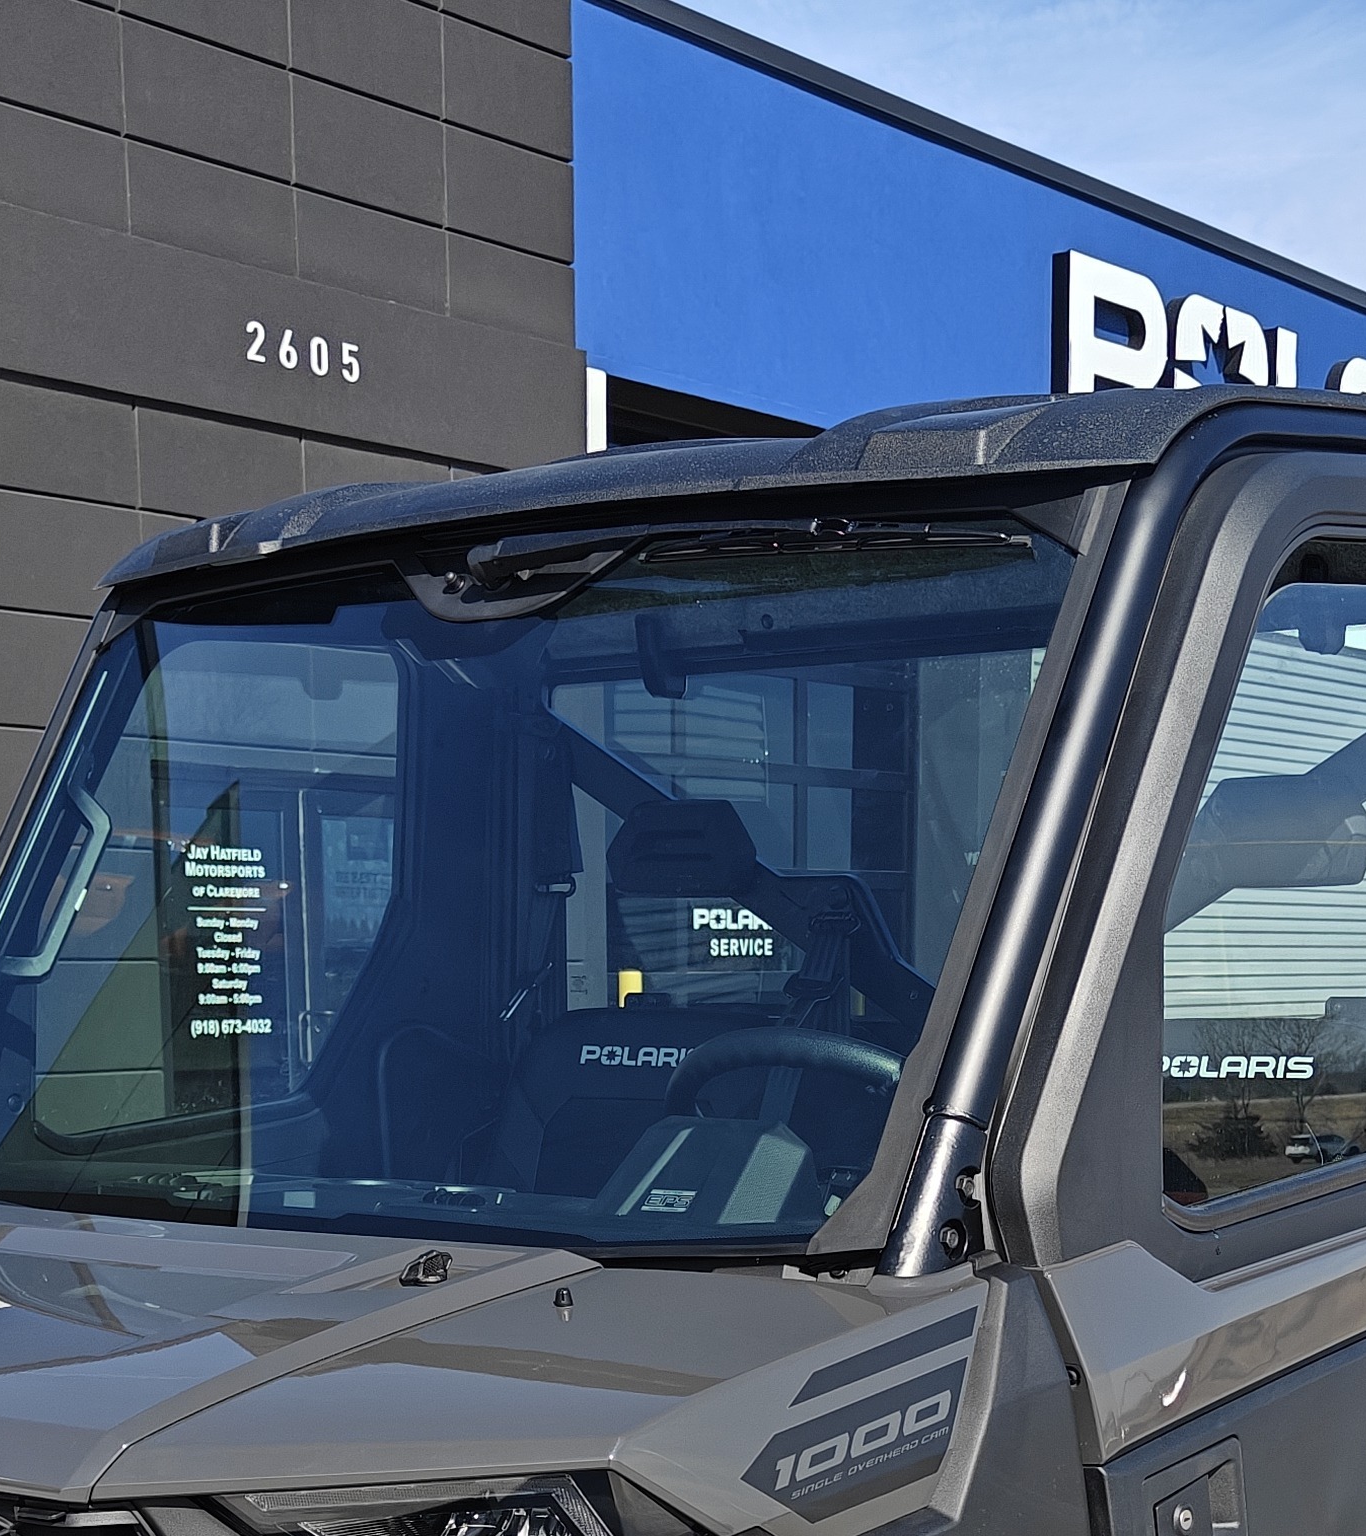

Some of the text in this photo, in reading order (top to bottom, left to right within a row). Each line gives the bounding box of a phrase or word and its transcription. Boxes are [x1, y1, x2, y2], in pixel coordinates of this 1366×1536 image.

[246, 320, 360, 383] 2605
[187, 844, 262, 861] JAY HATFIELD
[185, 861, 266, 878] MOTORSPORTS
[693, 908, 773, 930] POLAR
[710, 938, 773, 956] SERVICE
[191, 1019, 272, 1038] (918) 673-4032
[580, 1045, 694, 1067] POLARI
[775, 1389, 952, 1491] 1000
[790, 1426, 950, 1500] SINGLE OVERHEAD CAM
